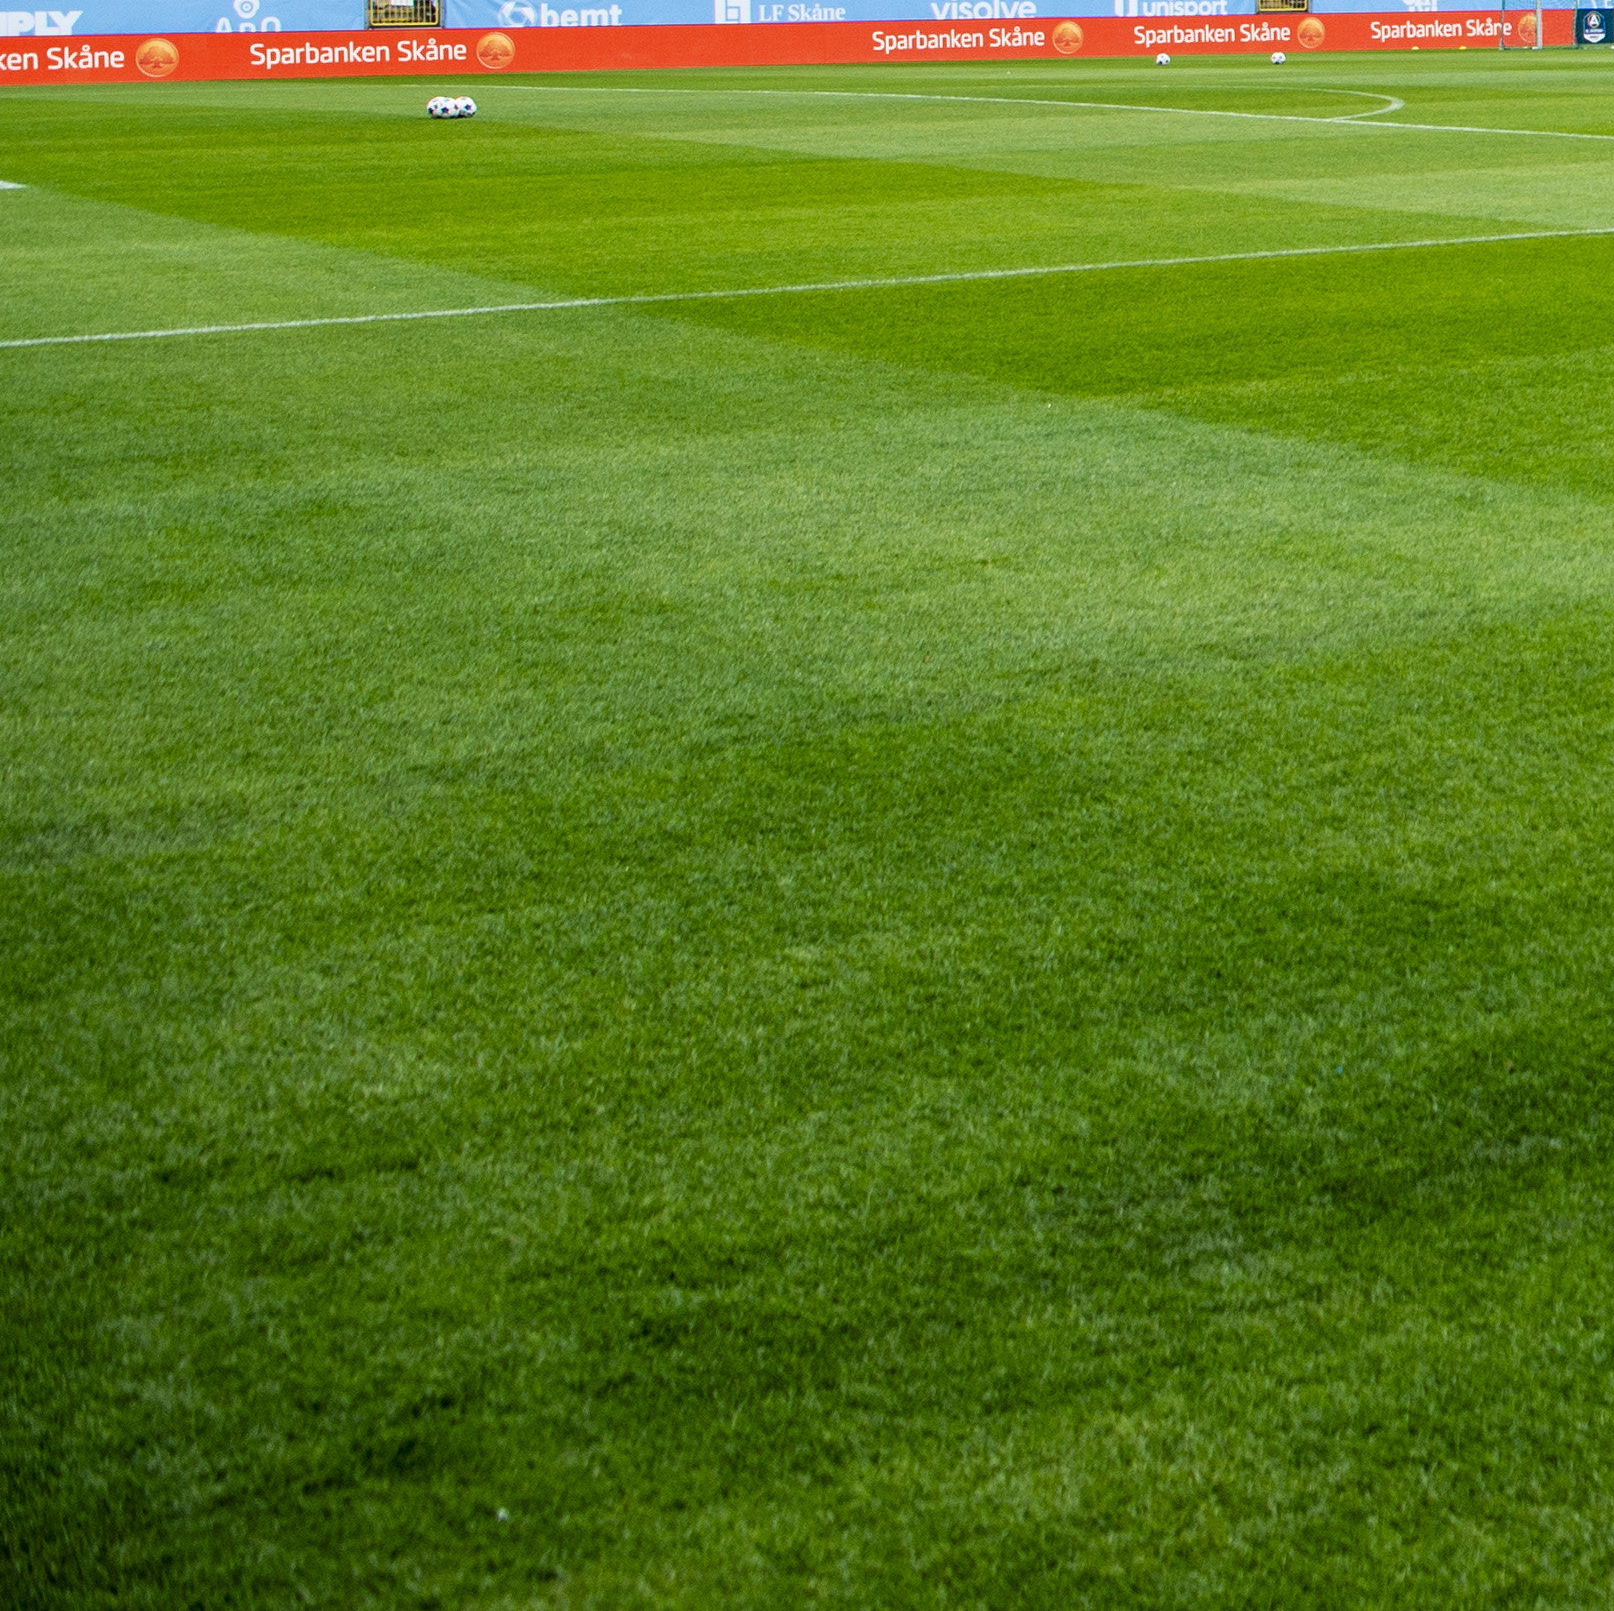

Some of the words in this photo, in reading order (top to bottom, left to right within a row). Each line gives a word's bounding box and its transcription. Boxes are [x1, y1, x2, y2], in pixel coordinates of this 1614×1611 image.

[541, 3, 622, 27] bemt
[758, 4, 784, 21] LF
[788, 2, 845, 21] Skåne
[872, 29, 983, 54] Sparbanken
[989, 26, 1045, 47] Skåne
[1134, 24, 1235, 48] Sparbanken
[1240, 22, 1291, 41] Skåne
[1370, 20, 1462, 42] Sparbanken
[1466, 17, 1512, 36] Skåne
[46, 45, 125, 70] Skåne
[250, 41, 390, 69] Sparbanken
[397, 38, 467, 63] Skåne
